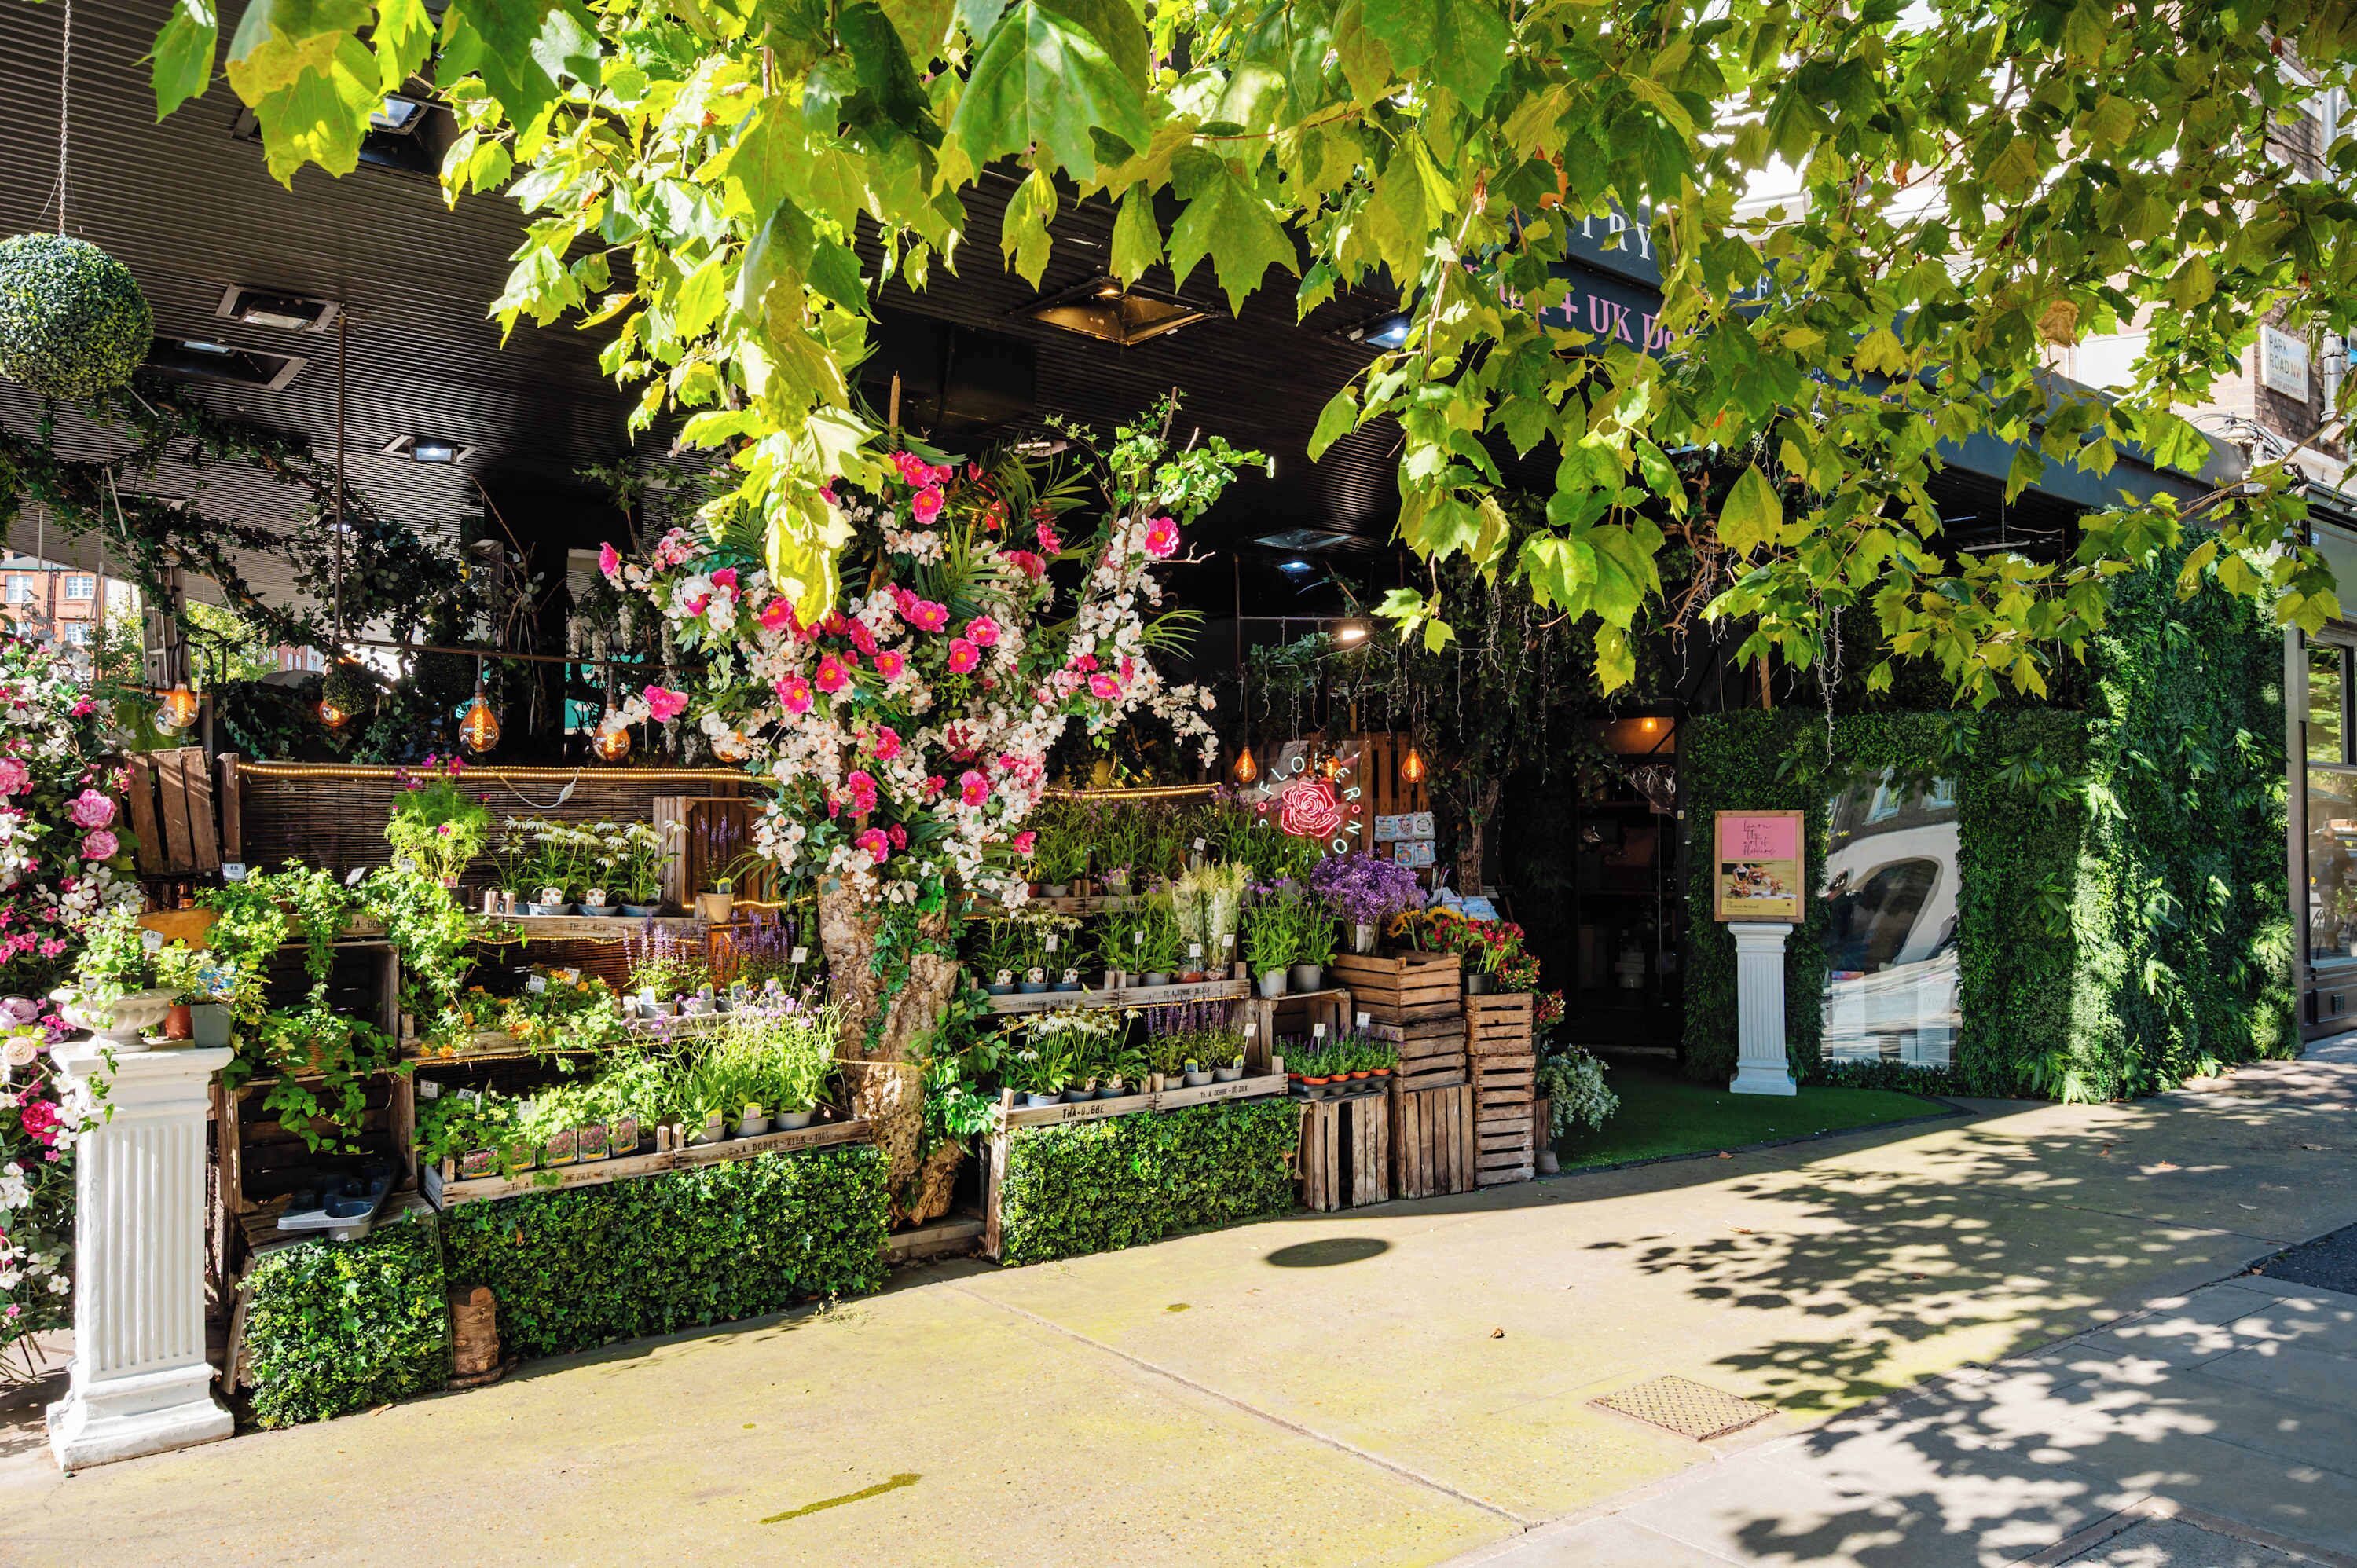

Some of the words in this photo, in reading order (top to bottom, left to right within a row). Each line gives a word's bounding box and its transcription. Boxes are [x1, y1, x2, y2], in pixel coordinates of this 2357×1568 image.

[1588, 294, 1633, 344] UK
[2269, 334, 2288, 356] PARK
[2269, 353, 2289, 374] ROAD
[753, 1138, 779, 1152] DOBBE
[787, 1135, 805, 1145] ZILK
